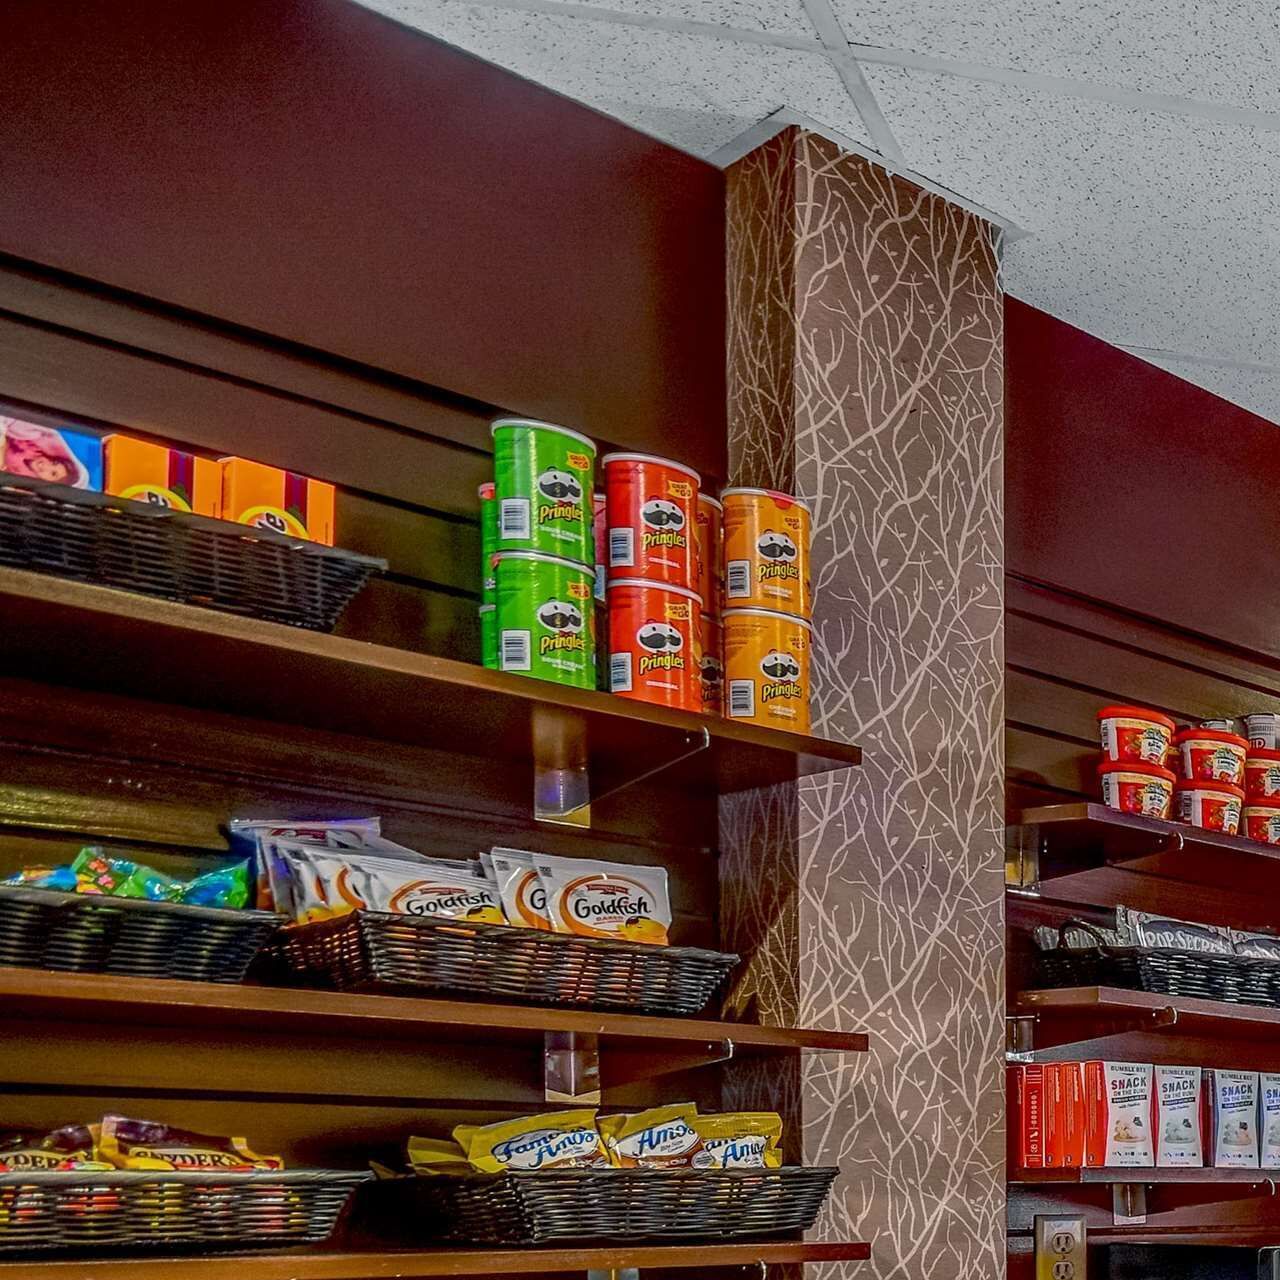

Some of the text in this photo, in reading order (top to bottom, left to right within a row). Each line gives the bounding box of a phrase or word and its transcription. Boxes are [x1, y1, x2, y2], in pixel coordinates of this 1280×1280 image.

[539, 503, 583, 524] Pringles
[642, 530, 687, 548] Pringles
[758, 562, 800, 584] Pringles
[540, 633, 584, 656] Pringles
[640, 653, 684, 675] Pringles
[762, 682, 802, 702] Pringles
[406, 889, 495, 917] Goldfish
[574, 897, 651, 919] Goldfish
[1112, 1077, 1146, 1090] SNACK
[1162, 1080, 1195, 1092] SNACK
[1222, 1084, 1252, 1096] SNACK
